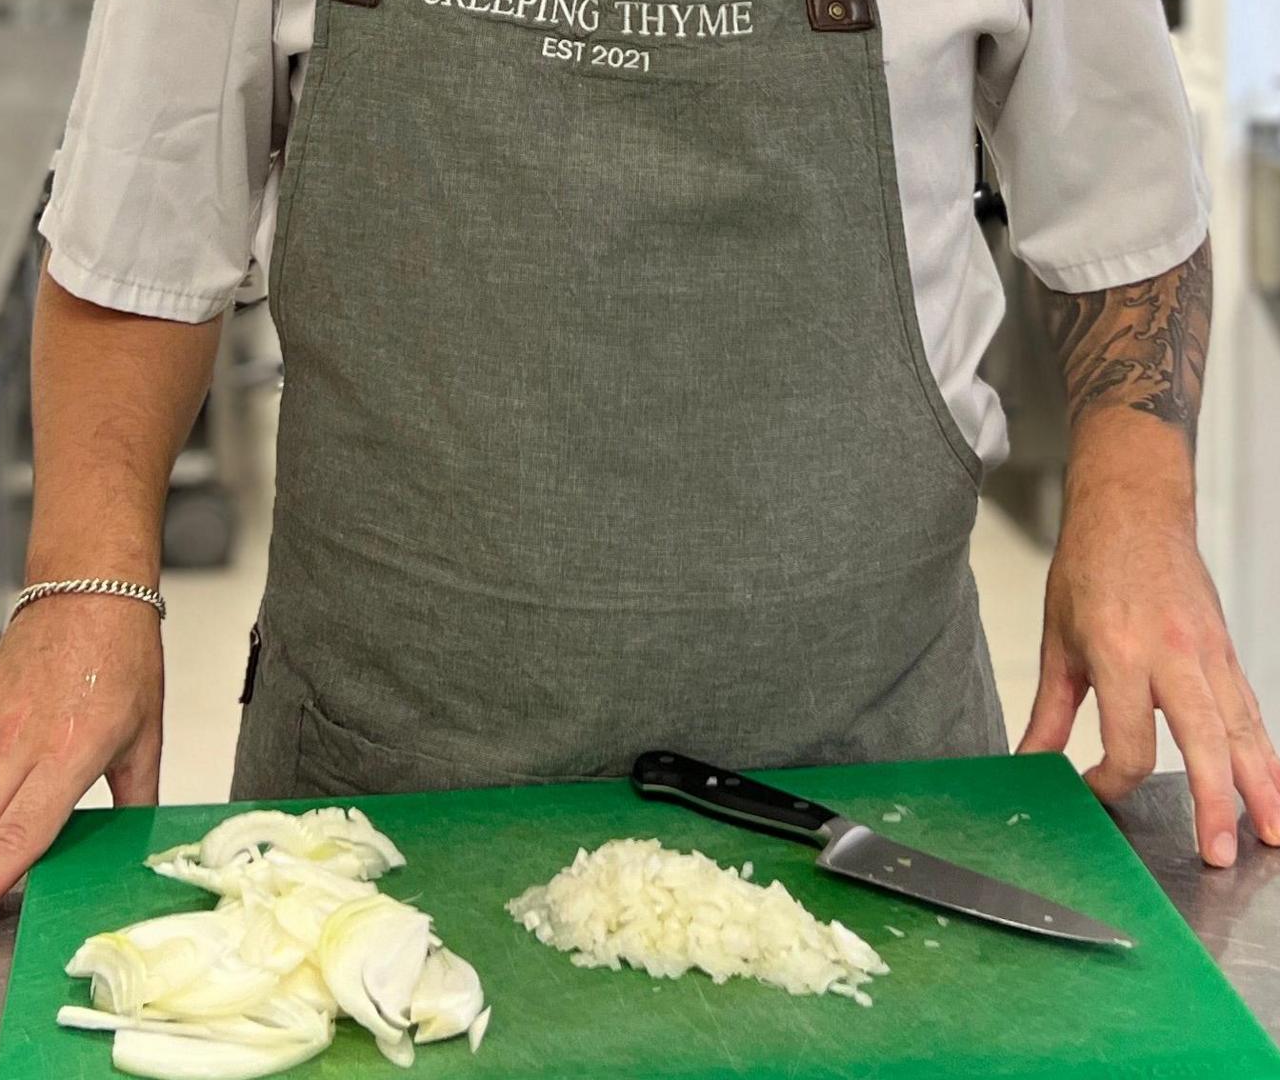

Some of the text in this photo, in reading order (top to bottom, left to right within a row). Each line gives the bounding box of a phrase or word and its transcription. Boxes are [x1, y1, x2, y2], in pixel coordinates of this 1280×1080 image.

[614, 0, 754, 38] THYME
[541, 37, 650, 73] EST 2021
